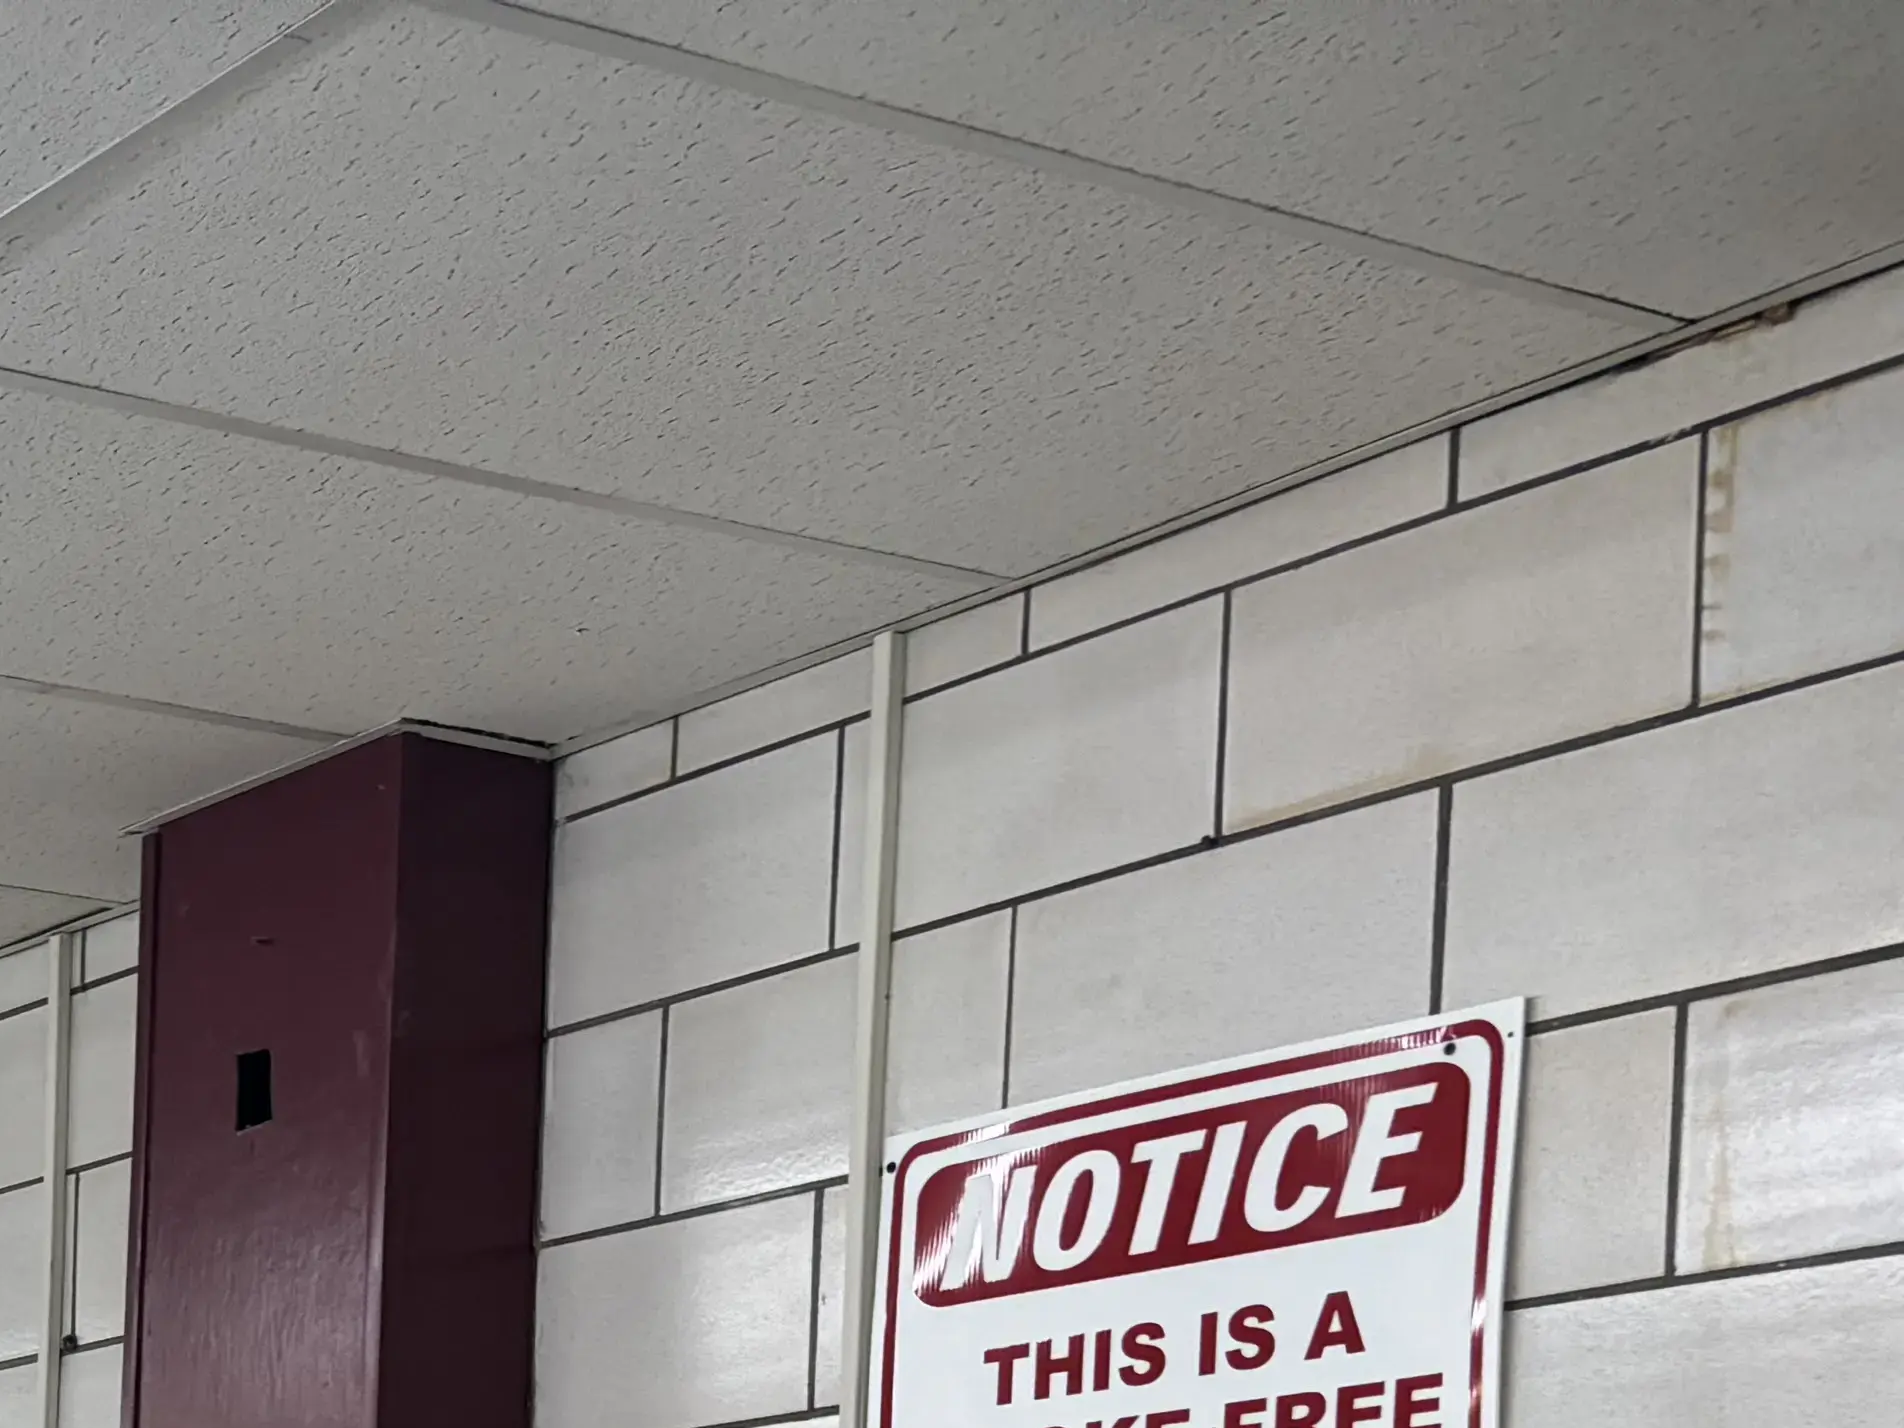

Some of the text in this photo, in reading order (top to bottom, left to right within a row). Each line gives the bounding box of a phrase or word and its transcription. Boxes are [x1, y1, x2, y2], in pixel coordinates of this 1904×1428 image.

[939, 1081, 1439, 1291] NOTICE
[983, 1290, 1365, 1405] THIS IS A
